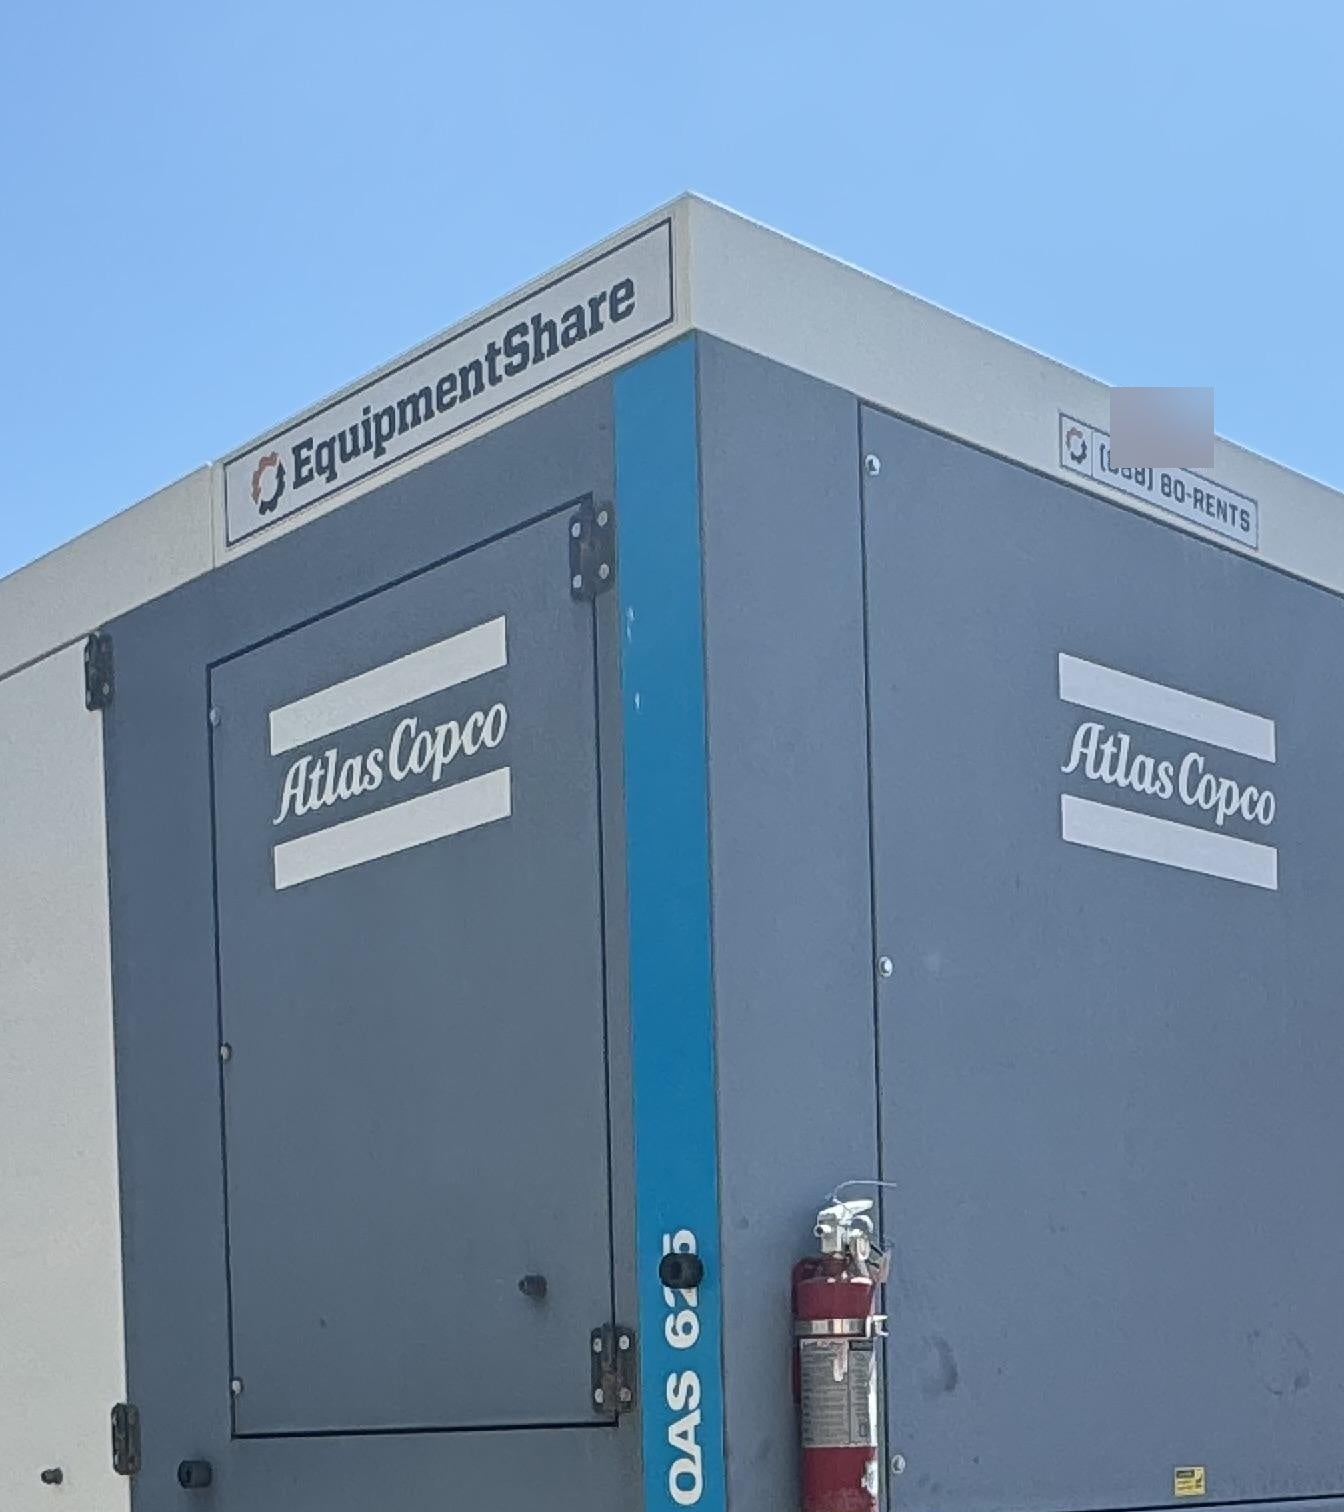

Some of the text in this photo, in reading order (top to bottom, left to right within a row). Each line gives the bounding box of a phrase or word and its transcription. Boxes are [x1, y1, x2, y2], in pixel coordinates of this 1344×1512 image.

[292, 277, 636, 490] EquipmentShare
[1160, 472, 1251, 533] 80-RENTS
[272, 702, 508, 826] Atlas Copco
[1060, 721, 1276, 826] Atlas Copco
